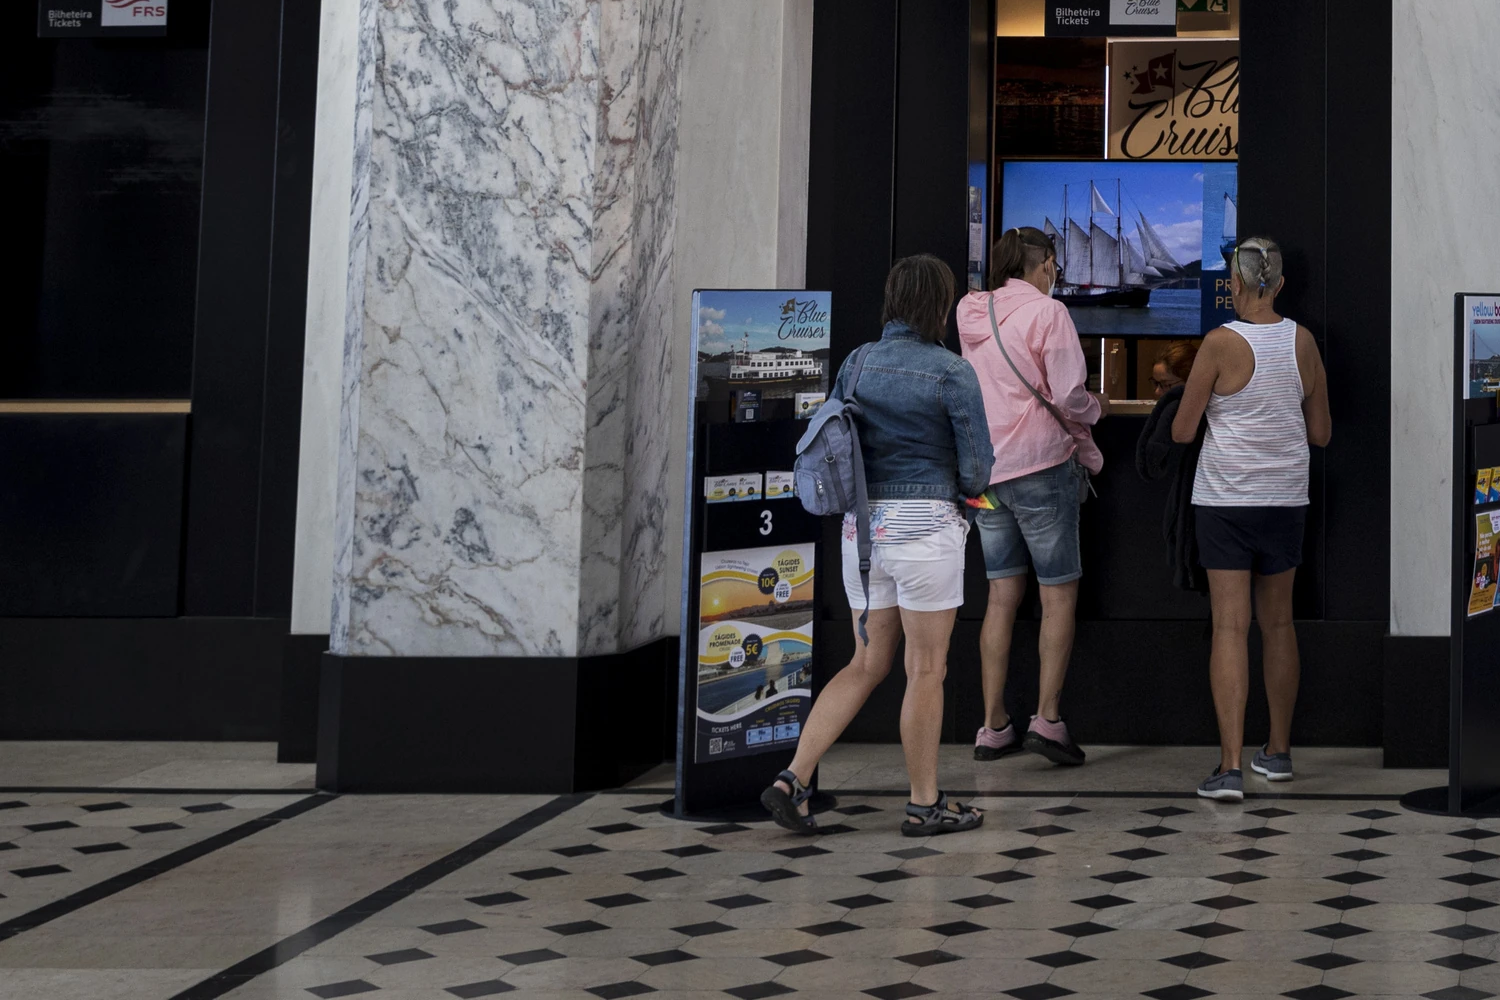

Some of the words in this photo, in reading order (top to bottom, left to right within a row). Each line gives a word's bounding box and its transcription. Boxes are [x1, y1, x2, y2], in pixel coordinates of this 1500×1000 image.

[48, 10, 92, 19] Bilheteira
[132, 6, 165, 17] FRS
[1055, 8, 1100, 17] Bilheteira
[1125, 2, 1160, 16] Cruises
[49, 19, 81, 27] Tickets
[1056, 17, 1089, 25] Tickets
[1178, 55, 1239, 118] Bl
[1120, 99, 1239, 159] Cruis
[1215, 279, 1232, 292] PR
[1215, 296, 1233, 309] PE
[796, 299, 827, 324] Blue
[1472, 301, 1494, 316] yellow
[777, 316, 826, 340] Cruises
[759, 509, 773, 536] 3
[777, 558, 800, 566] TÁGIDES
[779, 566, 799, 574] SUNSET
[761, 577, 775, 588] 10€
[776, 590, 789, 598] FREE
[715, 632, 736, 640] TÁGIDES
[709, 639, 741, 648] PROMENADE
[746, 643, 759, 656] 5€
[730, 654, 744, 663] FREE
[730, 722, 742, 731] HERE
